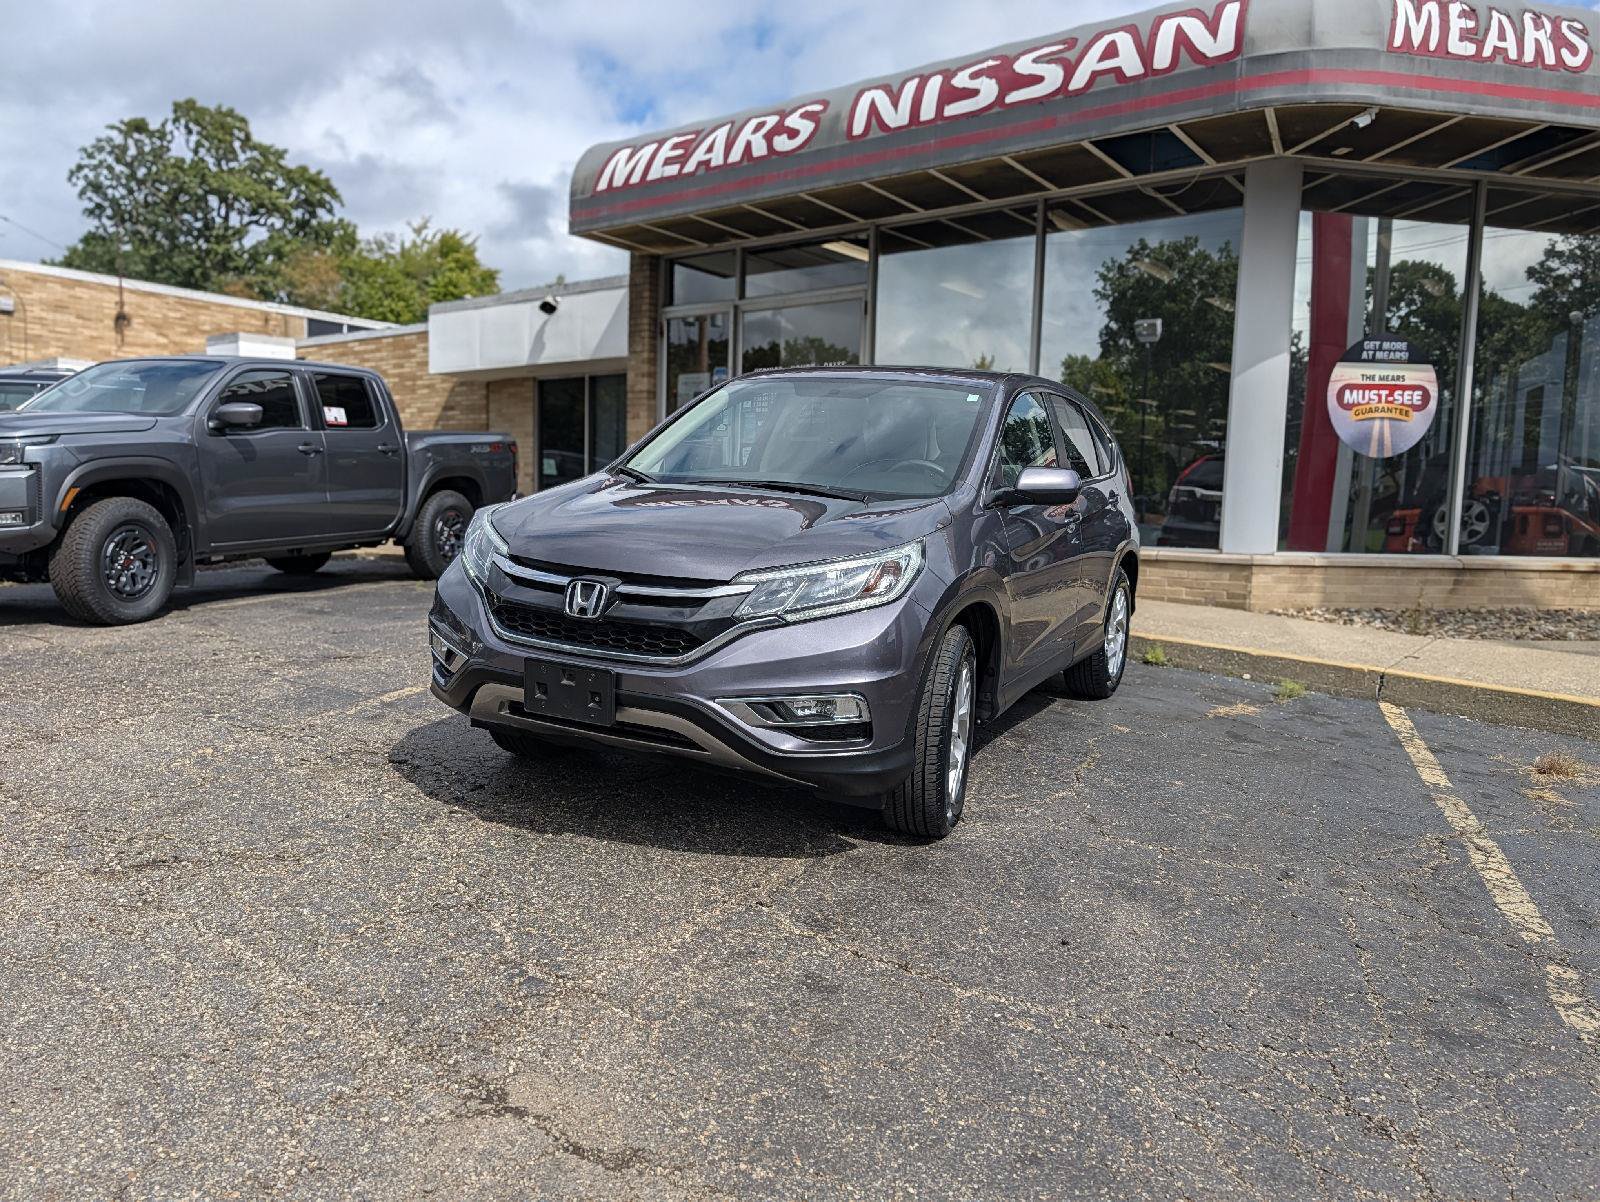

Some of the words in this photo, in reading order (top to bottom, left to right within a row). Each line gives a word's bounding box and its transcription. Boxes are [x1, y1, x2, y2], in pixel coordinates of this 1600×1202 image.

[1393, 0, 1589, 67] MEARS
[596, 103, 825, 192] MEARS
[851, 1, 1241, 136] NISSAN
[1363, 341, 1380, 350] GET
[1382, 341, 1408, 350] MORE
[1361, 351, 1374, 360] AT
[1375, 351, 1410, 360] MEARS!
[1361, 374, 1377, 382] THE
[1378, 374, 1406, 382] MEARS
[1343, 389, 1423, 405] MUST-SEE
[1354, 406, 1410, 418] GUARANTEE
